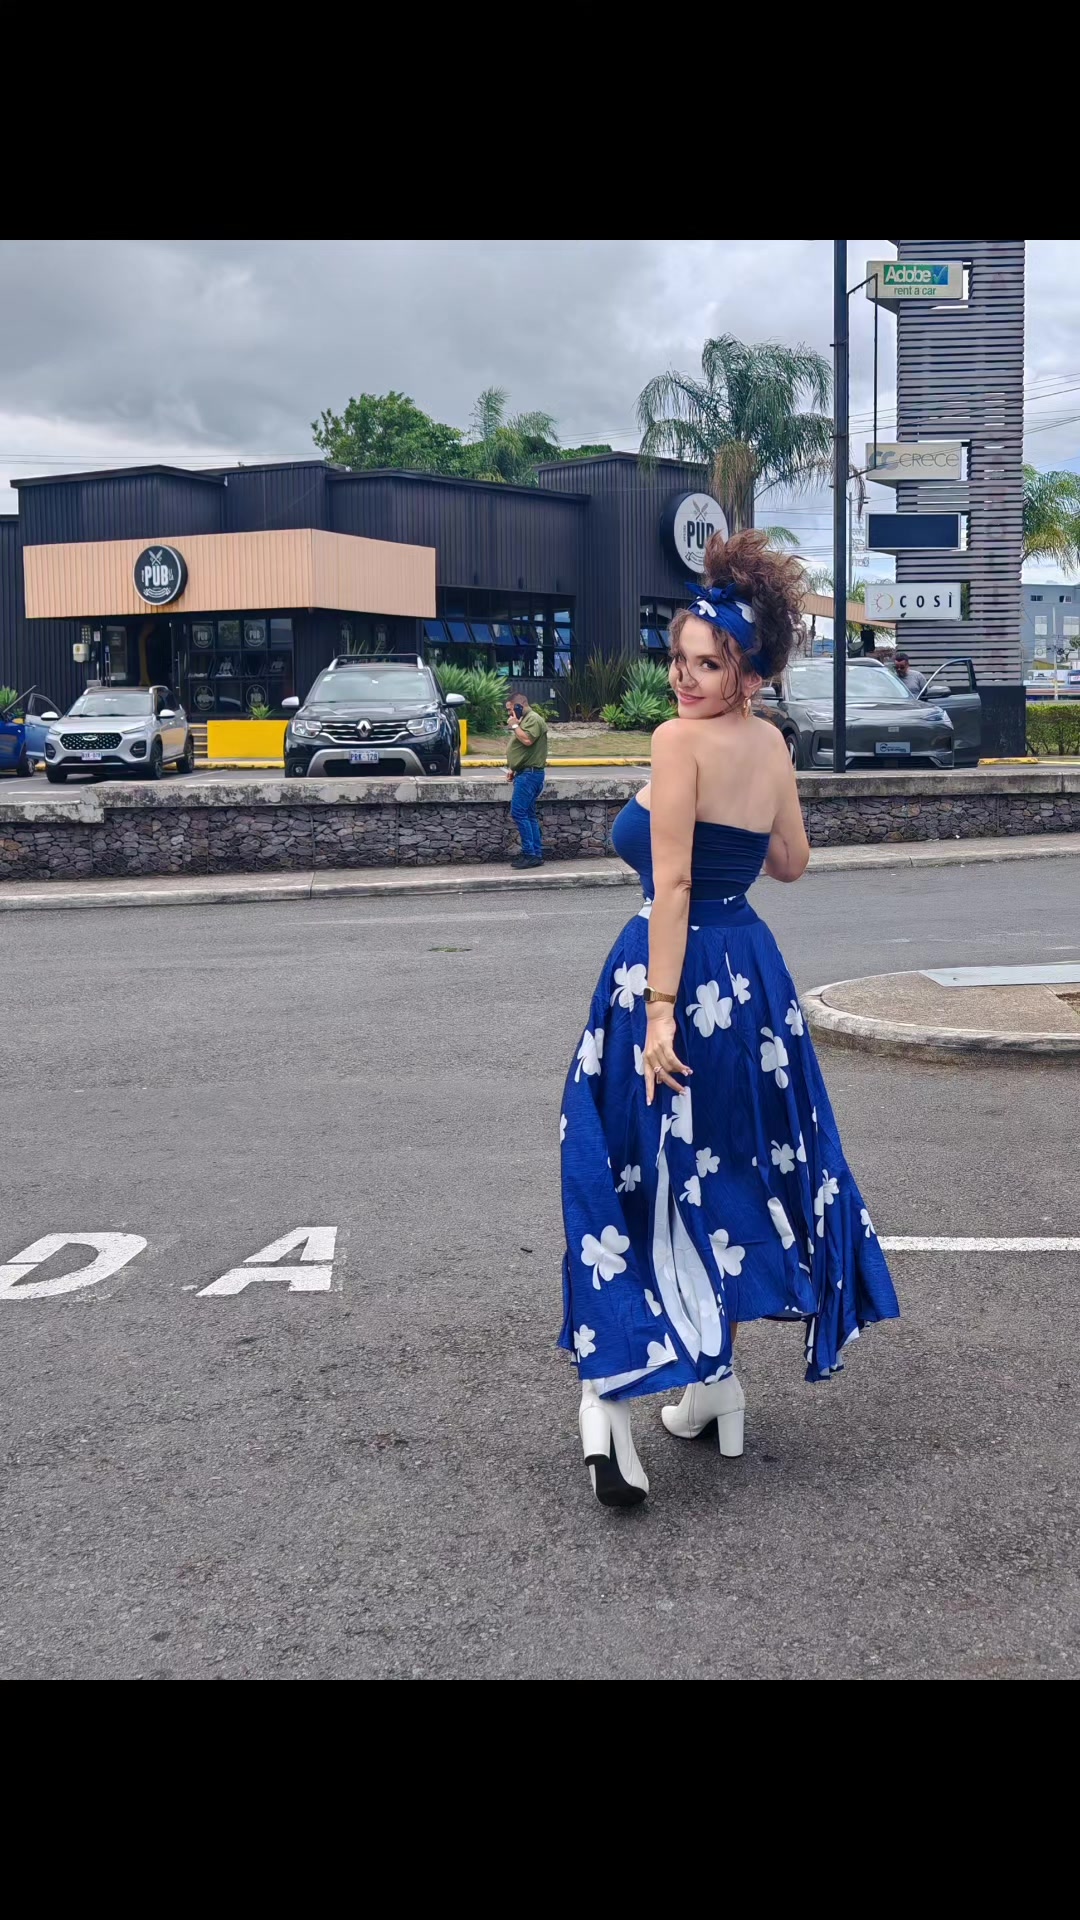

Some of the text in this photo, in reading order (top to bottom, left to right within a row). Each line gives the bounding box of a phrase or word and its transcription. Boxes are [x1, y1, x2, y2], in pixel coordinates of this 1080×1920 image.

[885, 265, 931, 283] Adobe
[894, 286, 912, 295] rent
[144, 565, 169, 587] PUB
[900, 592, 953, 608] COSÌ
